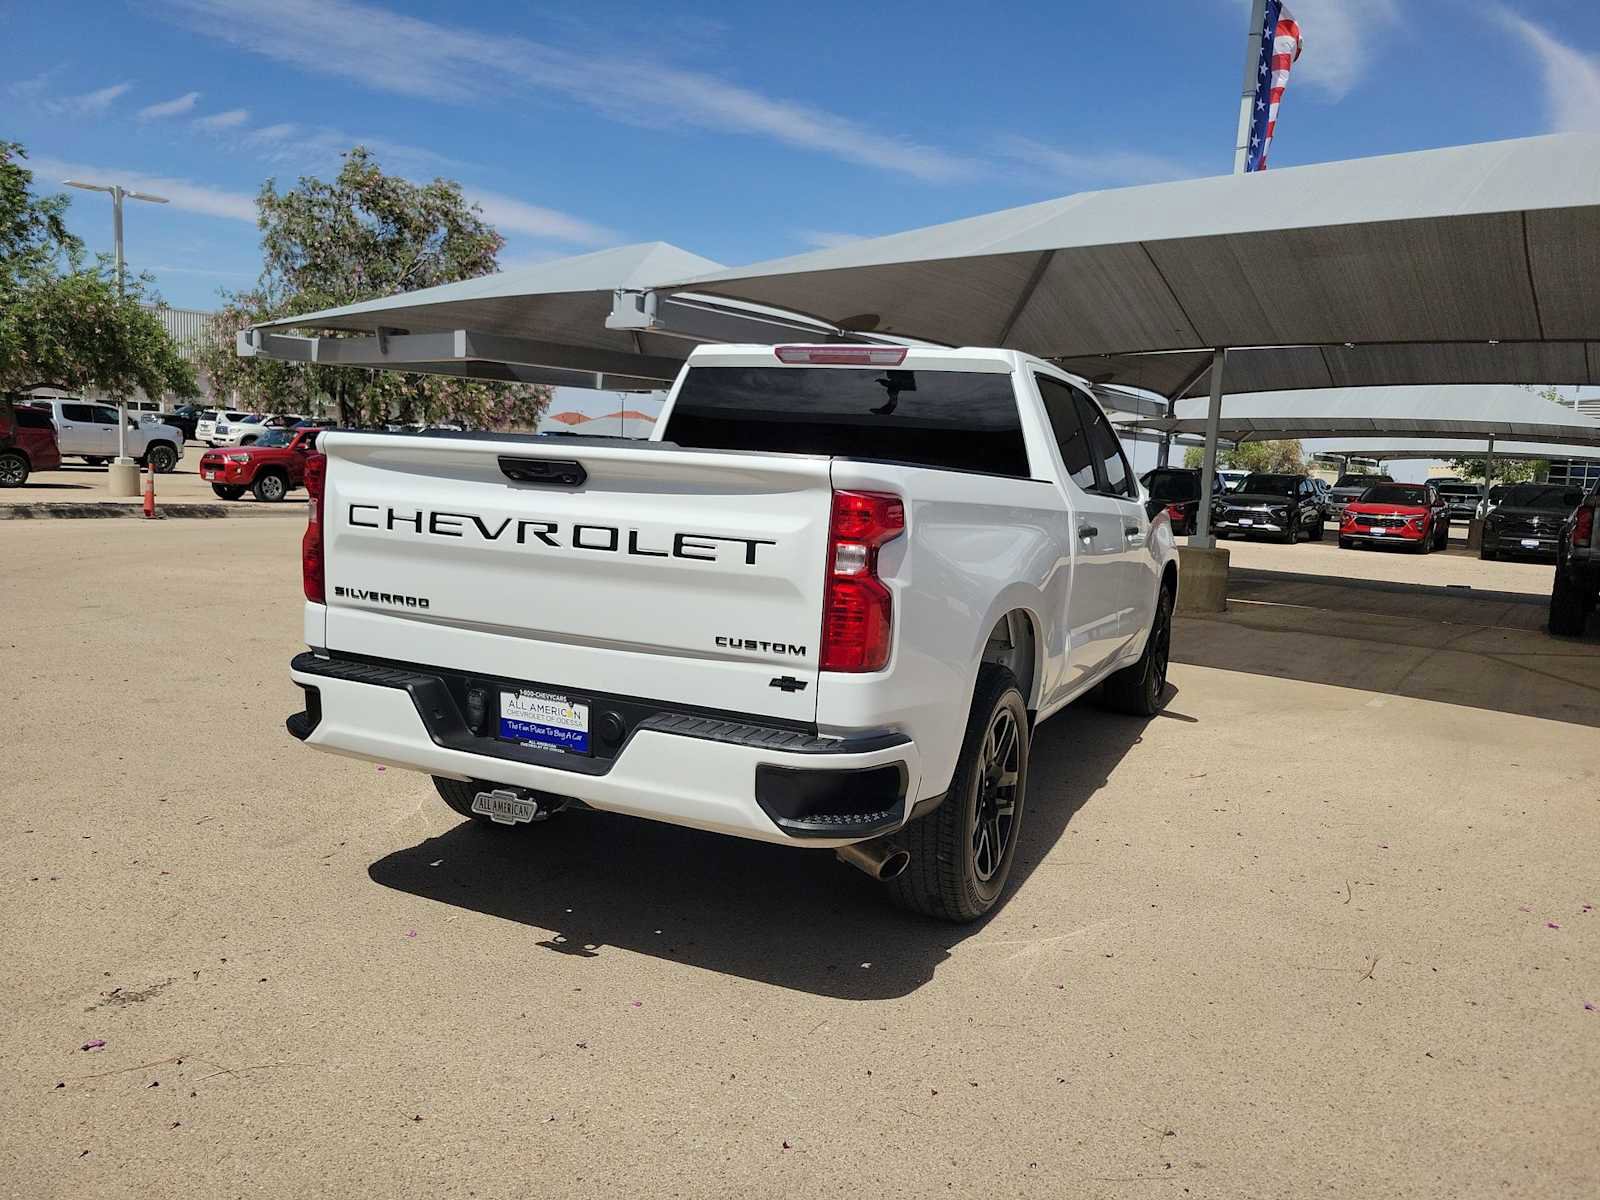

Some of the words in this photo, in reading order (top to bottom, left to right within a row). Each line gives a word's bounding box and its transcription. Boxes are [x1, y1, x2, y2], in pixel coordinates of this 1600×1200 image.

[350, 504, 776, 565] CHEVROLET
[335, 586, 430, 609] SILVERADO
[715, 636, 807, 657] CUSTOM
[508, 699, 527, 711] ALL
[530, 703, 581, 720] AMERICN
[546, 727, 554, 736] To
[479, 797, 492, 810] ALL
[492, 799, 530, 817] AMERICAN
